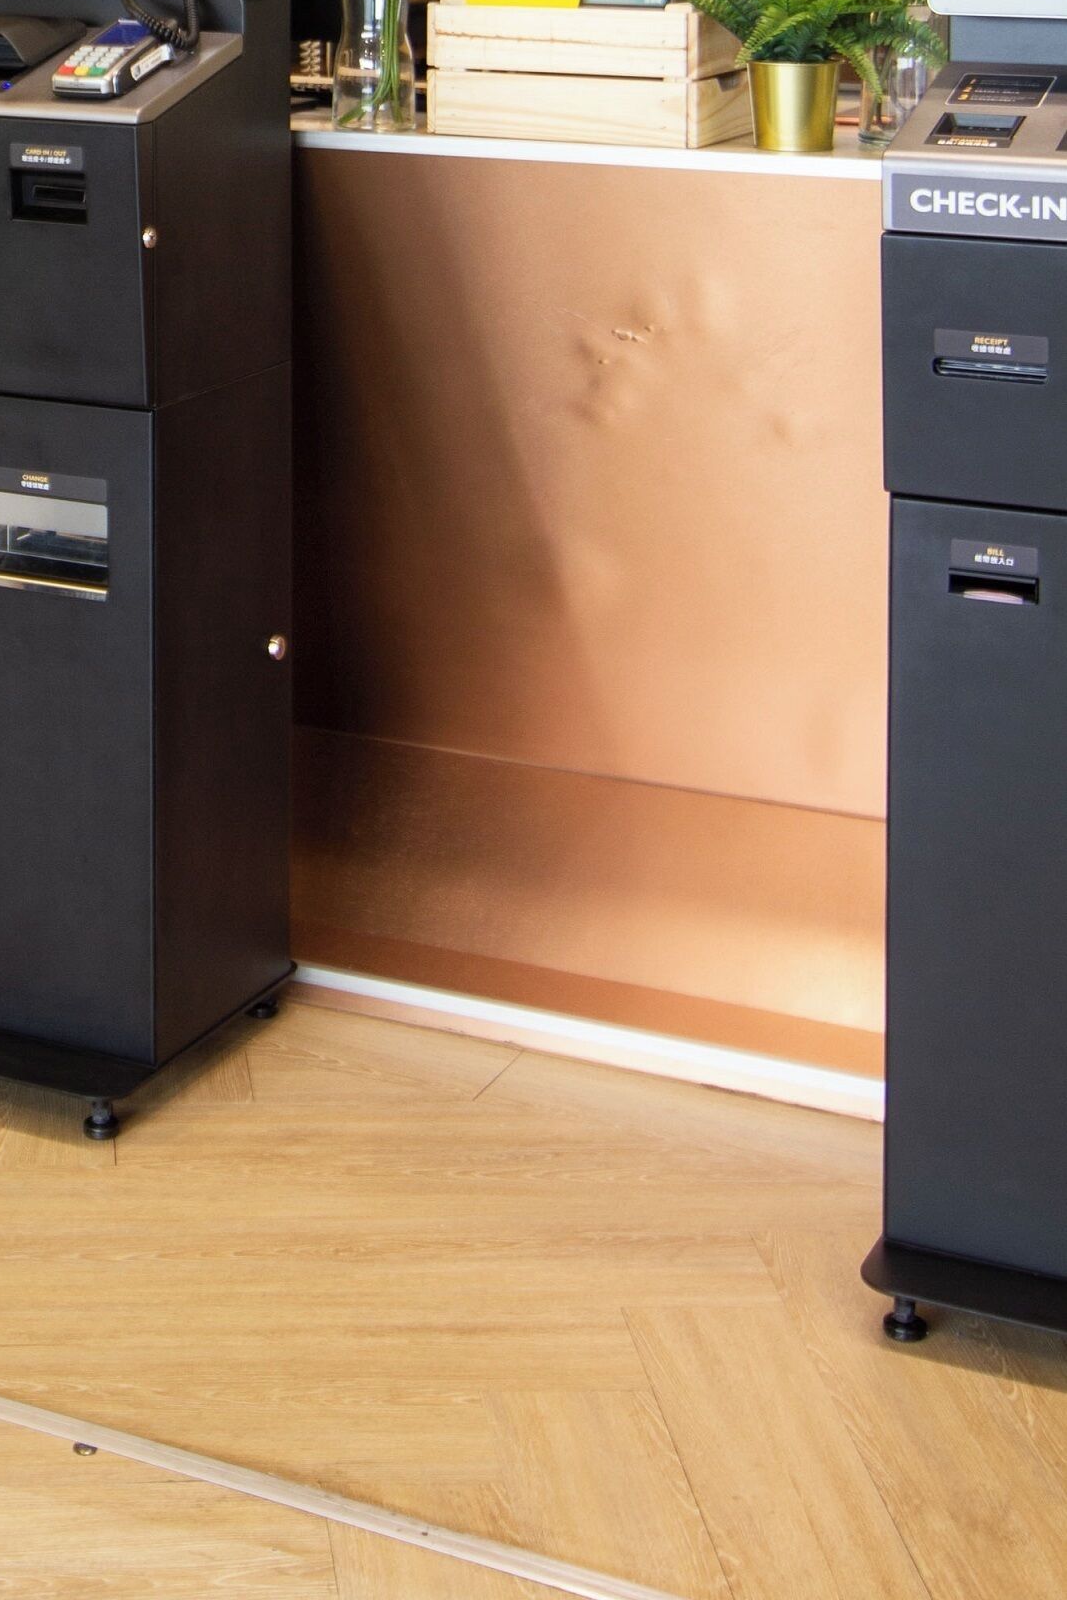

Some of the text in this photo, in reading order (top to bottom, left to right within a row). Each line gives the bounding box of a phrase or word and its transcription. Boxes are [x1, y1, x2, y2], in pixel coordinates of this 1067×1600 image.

[909, 188, 1067, 221] CHECK-IN
[974, 336, 1008, 346] RECEIPT
[986, 547, 1004, 556] BILL
